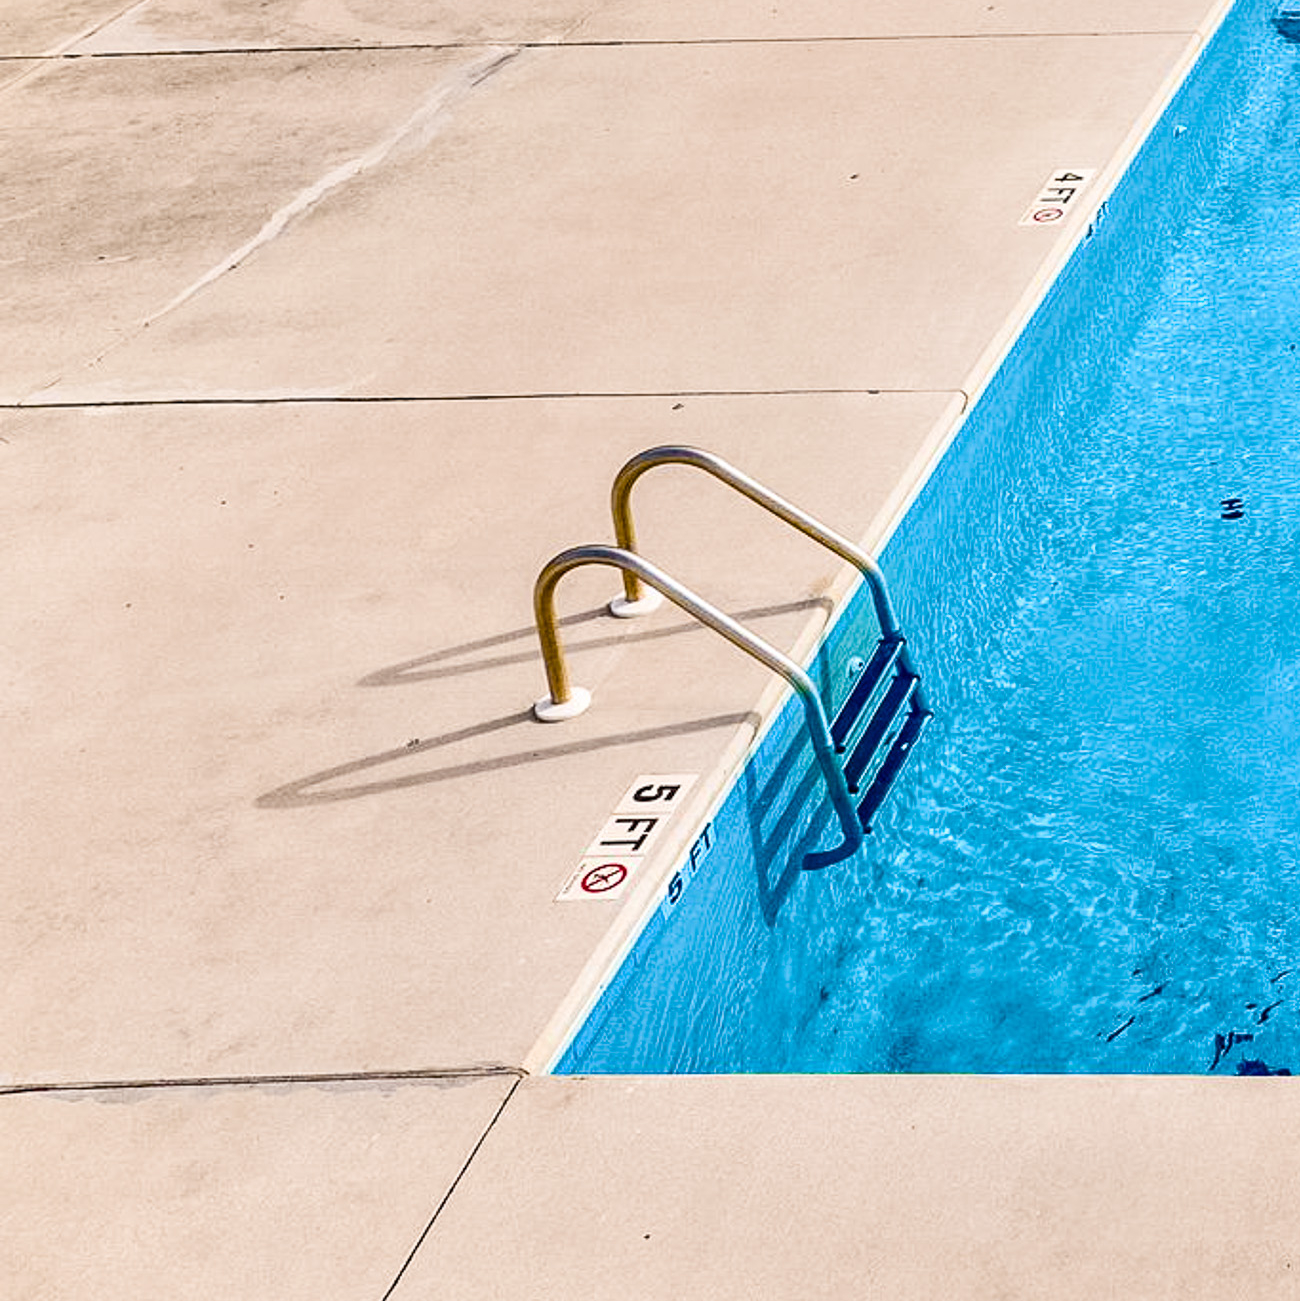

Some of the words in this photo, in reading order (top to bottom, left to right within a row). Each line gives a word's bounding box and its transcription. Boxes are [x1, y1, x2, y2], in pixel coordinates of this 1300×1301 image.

[1055, 172, 1084, 182] 4
[1040, 187, 1077, 204] FT
[633, 784, 682, 802] 5
[600, 818, 660, 851] FT
[668, 871, 683, 904] 5
[689, 822, 711, 872] FT
